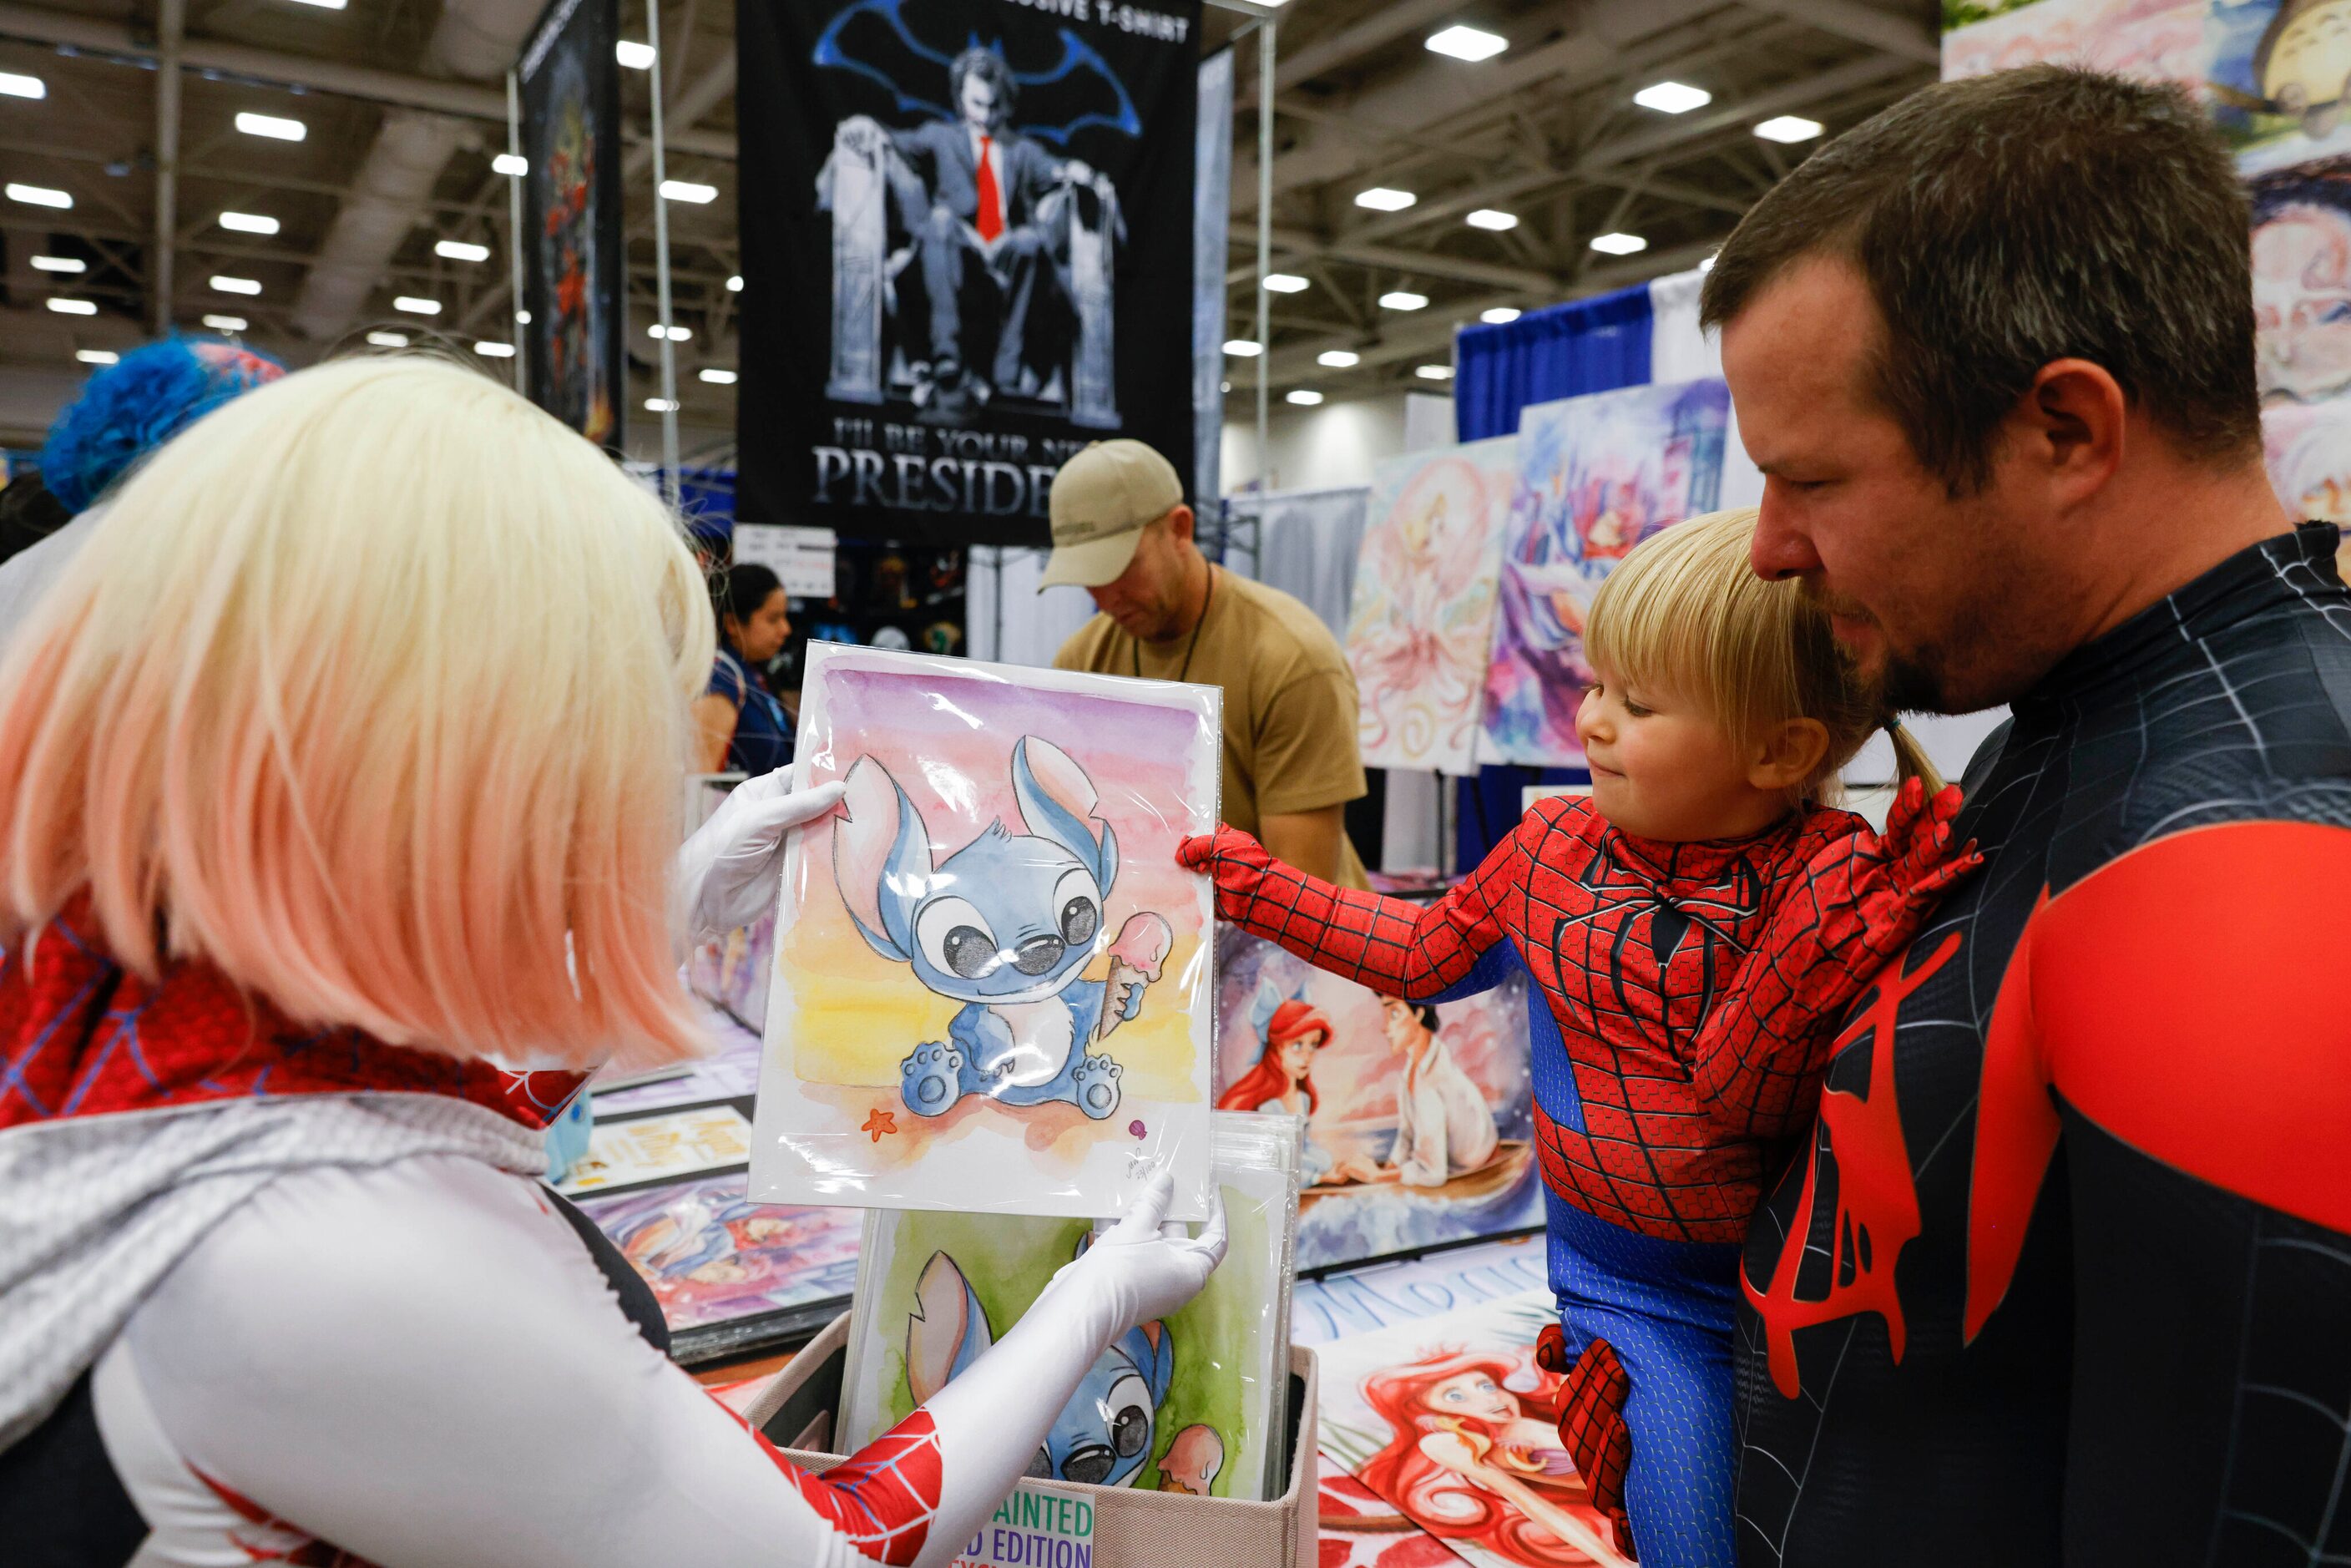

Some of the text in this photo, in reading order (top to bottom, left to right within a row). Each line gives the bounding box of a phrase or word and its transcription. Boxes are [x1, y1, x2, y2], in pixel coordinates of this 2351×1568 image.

[1095, 0, 1190, 43] T-SHIRT
[883, 422, 926, 453] BE
[935, 427, 1029, 461] YOUR
[811, 445, 1059, 518] PRESIDE
[992, 1490, 1093, 1537] AINTED
[993, 1529, 1091, 1568] EDITION
